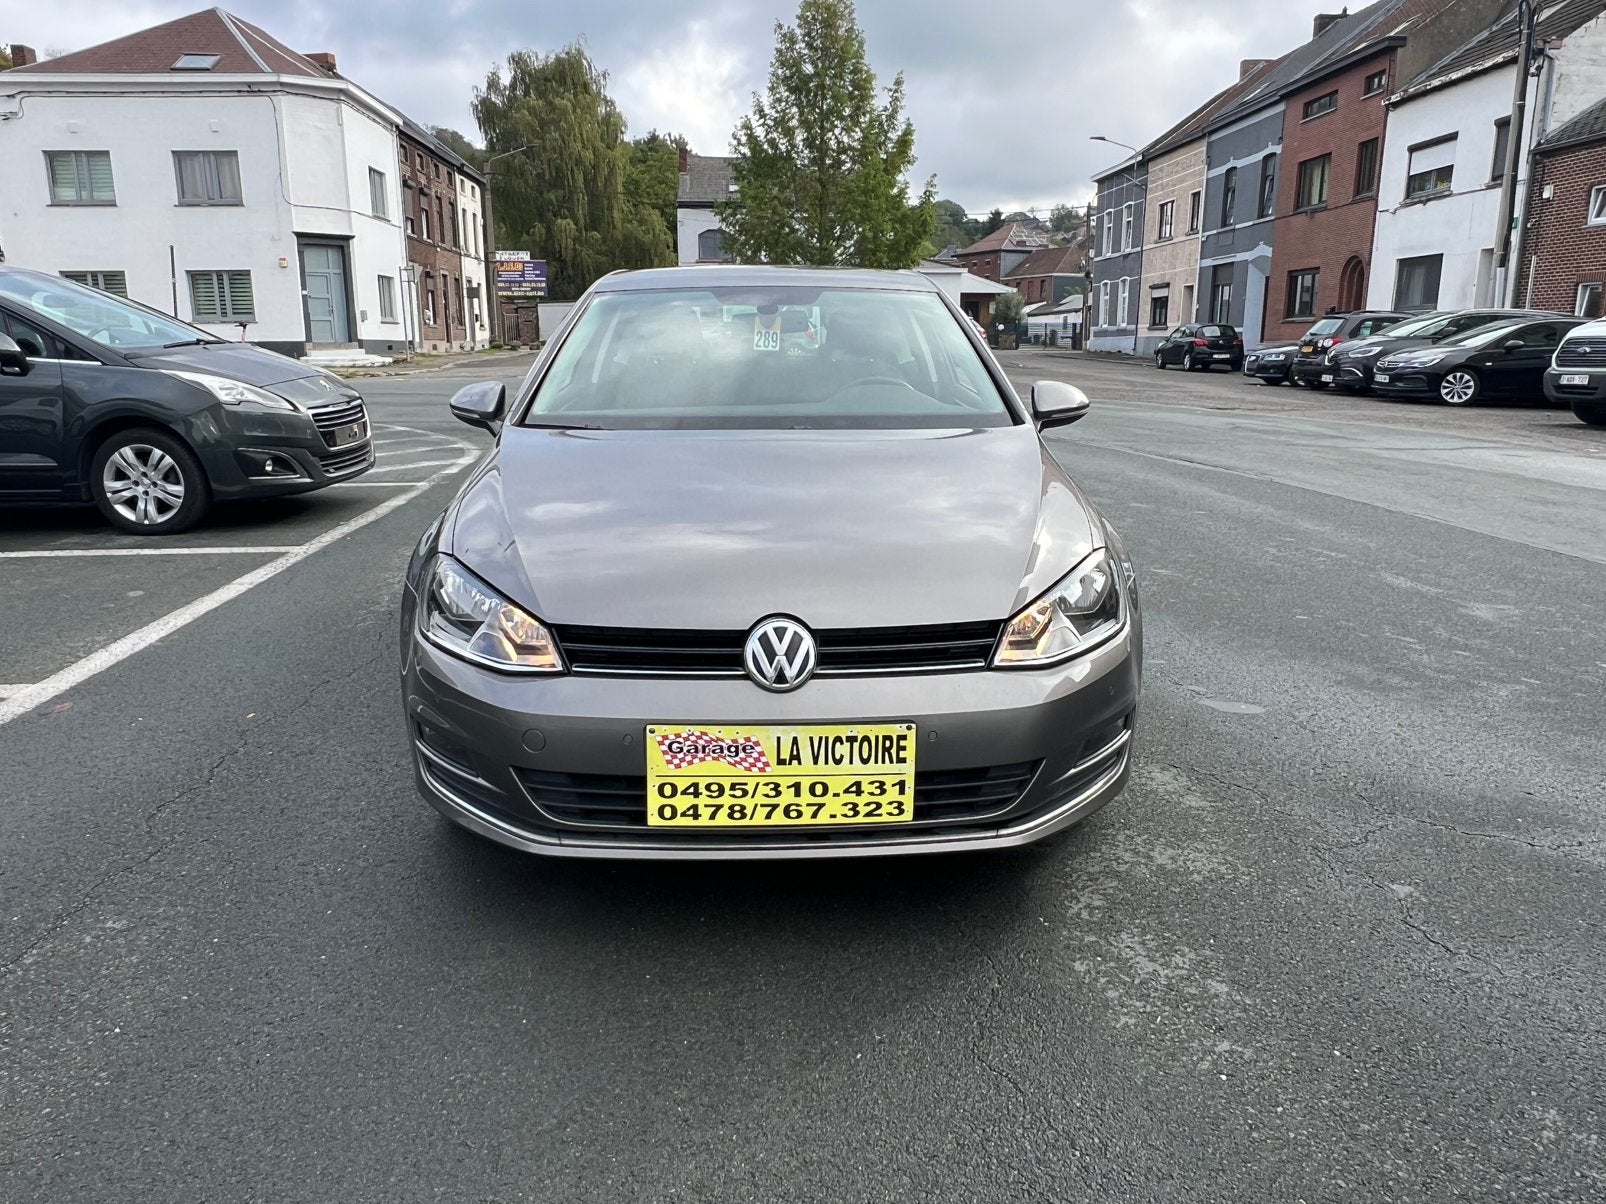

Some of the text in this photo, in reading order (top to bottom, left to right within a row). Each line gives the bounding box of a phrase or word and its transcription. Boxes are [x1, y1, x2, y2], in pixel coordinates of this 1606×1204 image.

[755, 331, 778, 349] 289
[667, 740, 756, 758] Garage
[776, 734, 908, 766] LA VICTOIRE
[657, 779, 907, 799] 0495/310.431
[657, 801, 906, 821] 0478/767.323
